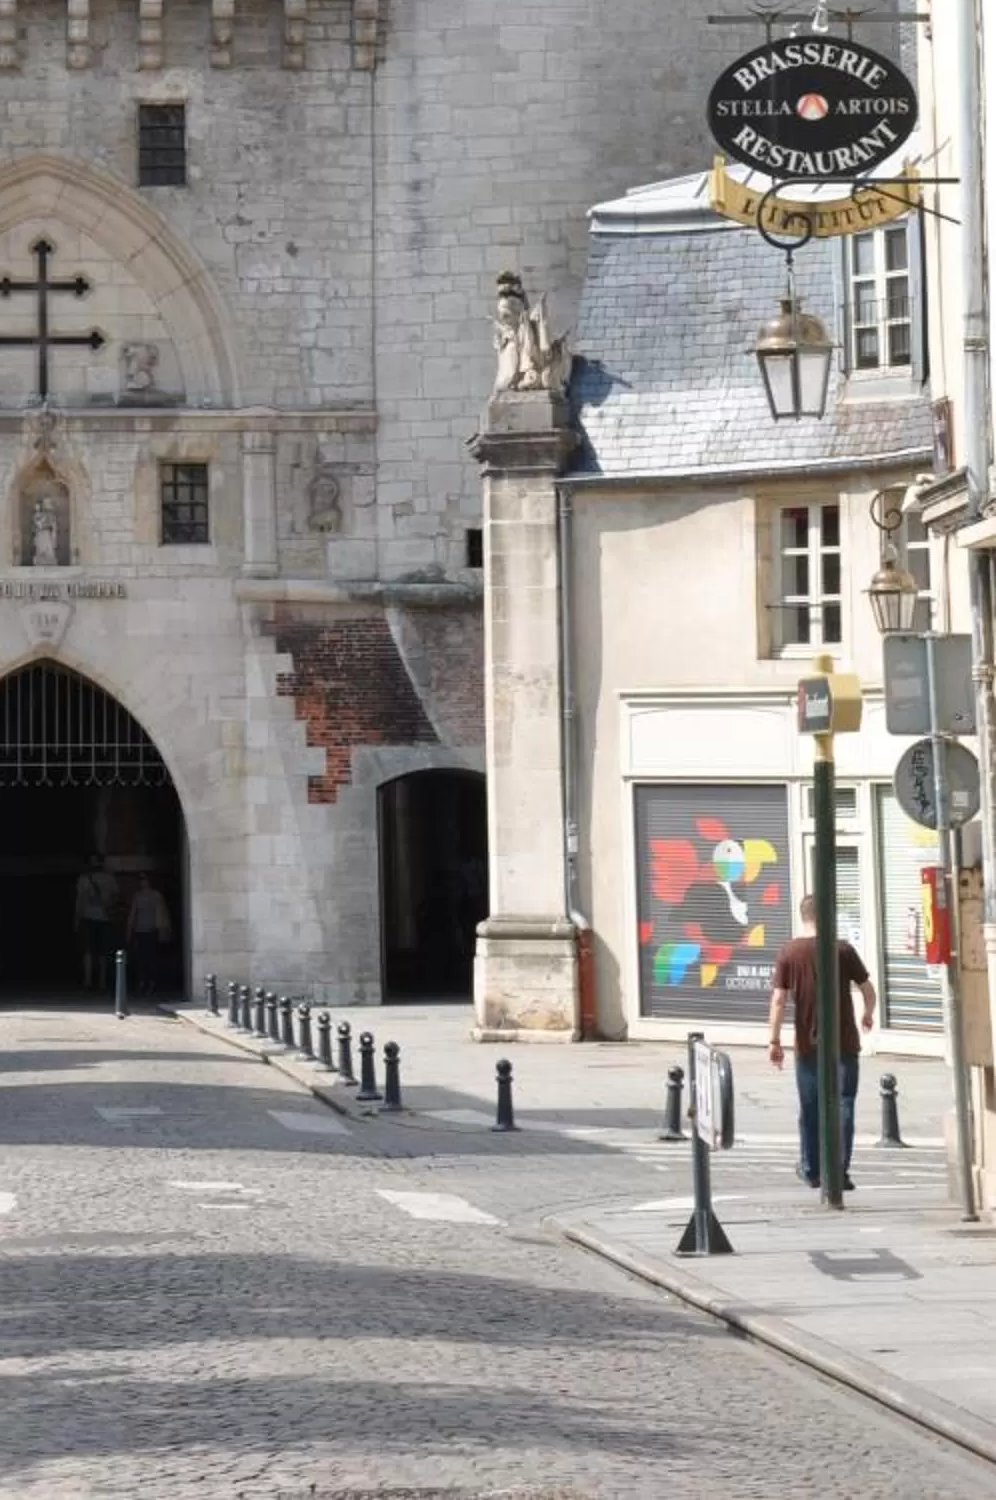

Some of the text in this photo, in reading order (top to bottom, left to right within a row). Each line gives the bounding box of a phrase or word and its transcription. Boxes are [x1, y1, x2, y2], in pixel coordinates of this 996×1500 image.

[732, 43, 888, 92] BRASSERIE
[716, 97, 909, 117] STELLA ARTOIS
[732, 118, 898, 175] RESTAURANT
